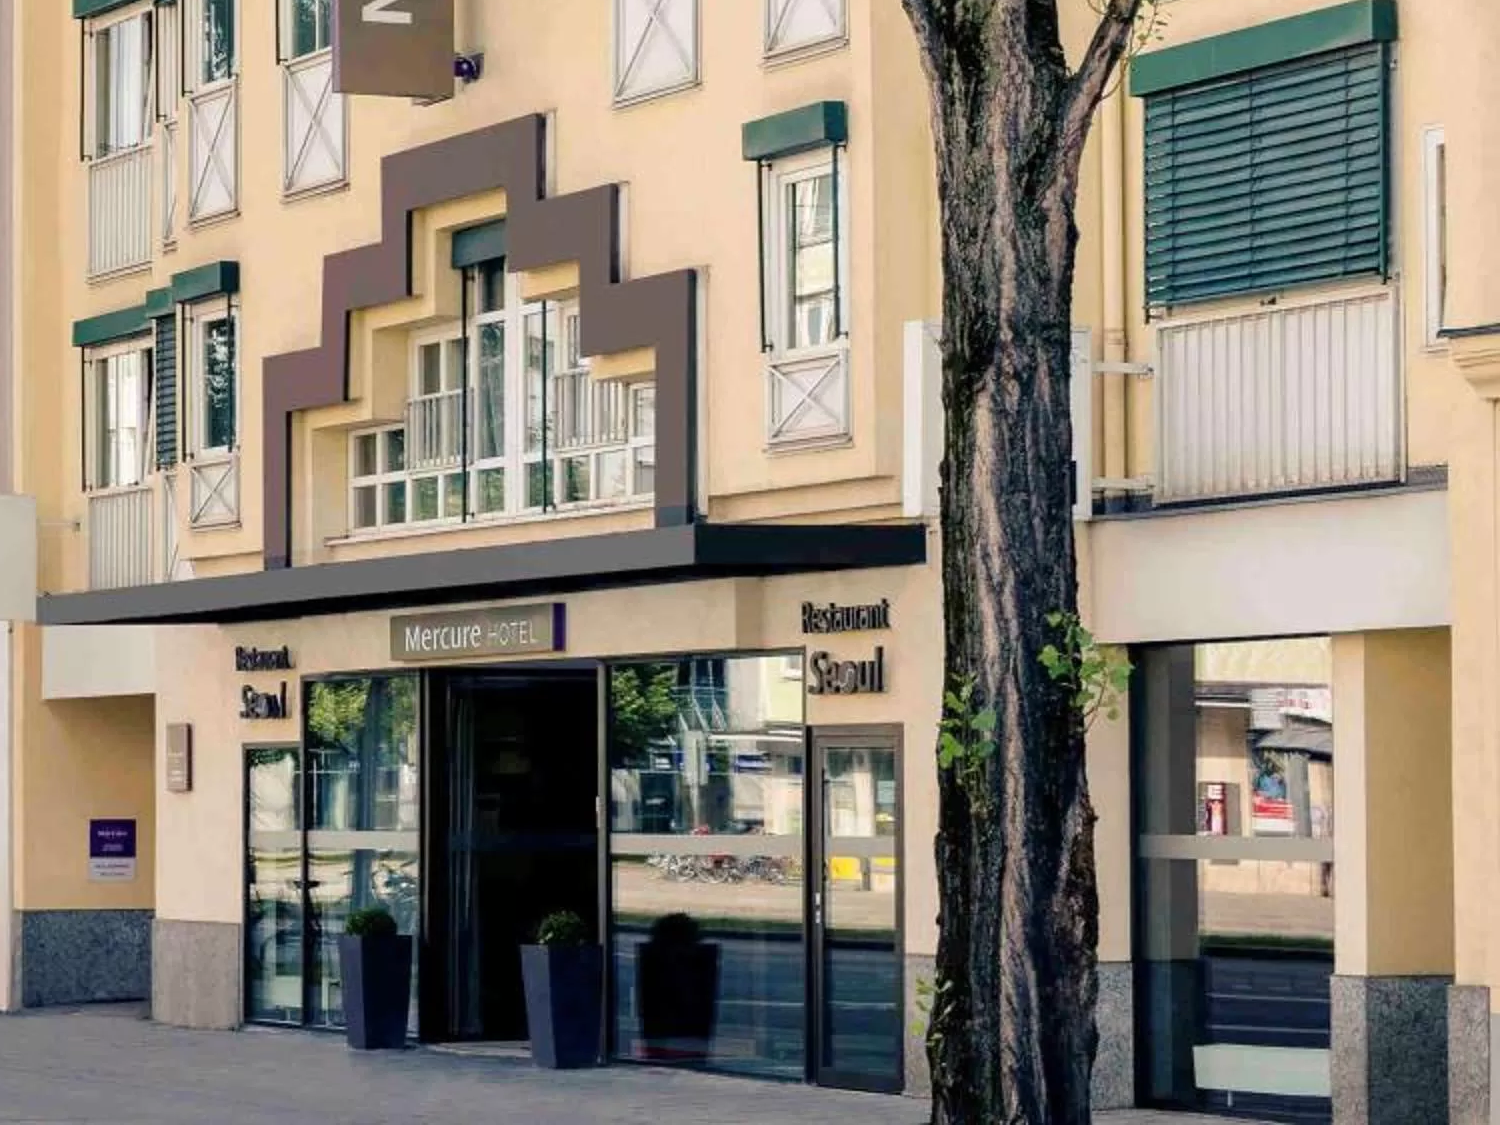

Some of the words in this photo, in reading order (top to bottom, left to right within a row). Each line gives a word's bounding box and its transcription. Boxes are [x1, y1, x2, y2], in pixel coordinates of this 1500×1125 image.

[801, 598, 889, 633] Restaurant
[405, 625, 481, 652] Mercure
[487, 620, 539, 647] HOTEL
[808, 646, 884, 695] Seoul
